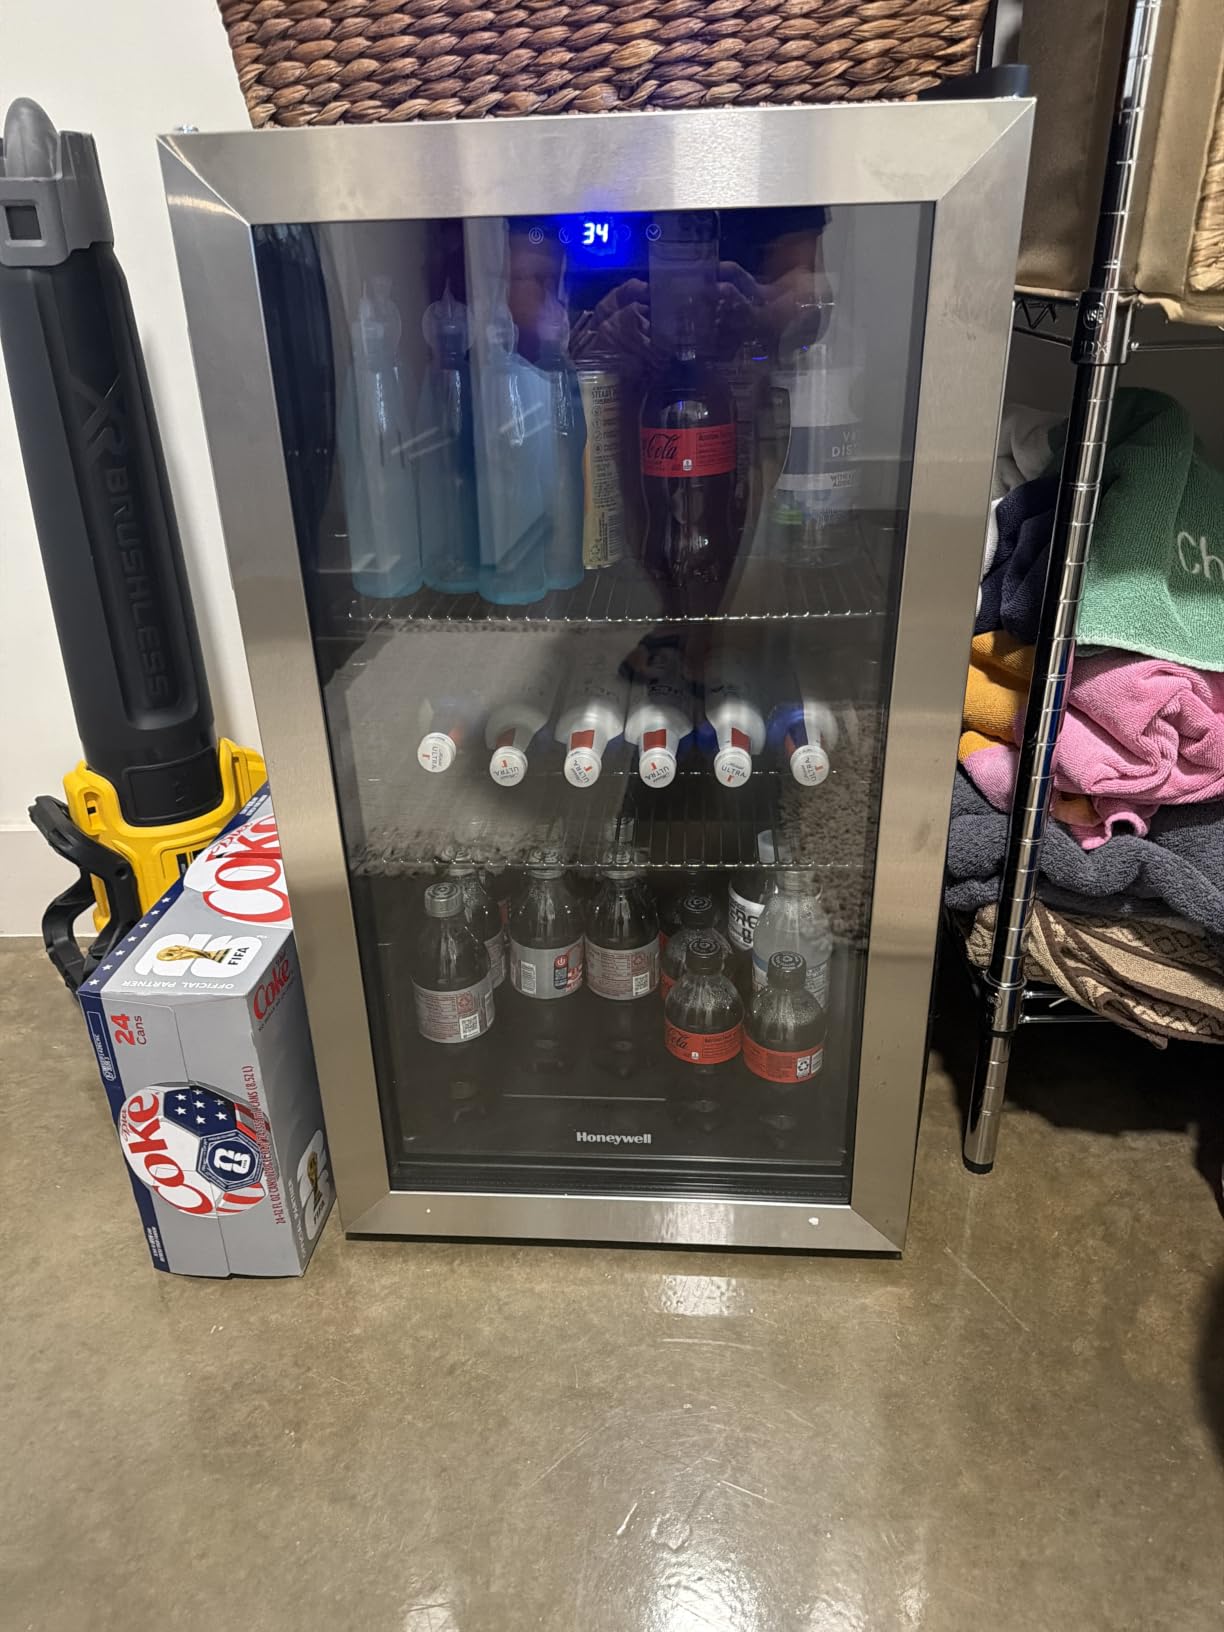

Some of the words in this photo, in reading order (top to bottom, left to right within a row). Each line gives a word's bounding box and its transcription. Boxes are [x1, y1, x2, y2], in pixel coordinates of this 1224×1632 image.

[582, 222, 609, 245] 34
[106, 467, 170, 698] BRUSHLESS
[431, 746, 439, 769] ULTRA
[494, 766, 520, 777] ULTRA
[573, 759, 590, 784] ULTRA
[645, 766, 670, 781] ULTRA
[721, 764, 747, 778] ULTRA
[227, 946, 250, 966] FIFA
[121, 980, 177, 989] PARTNER
[181, 982, 235, 990] OFFICIAL
[253, 959, 289, 1020] Coke
[110, 1013, 135, 1046] 24
[134, 1015, 147, 1045] Cans
[121, 1108, 131, 1142] Diet
[576, 1131, 652, 1145] Honeywell
[128, 1093, 213, 1215] Coke
